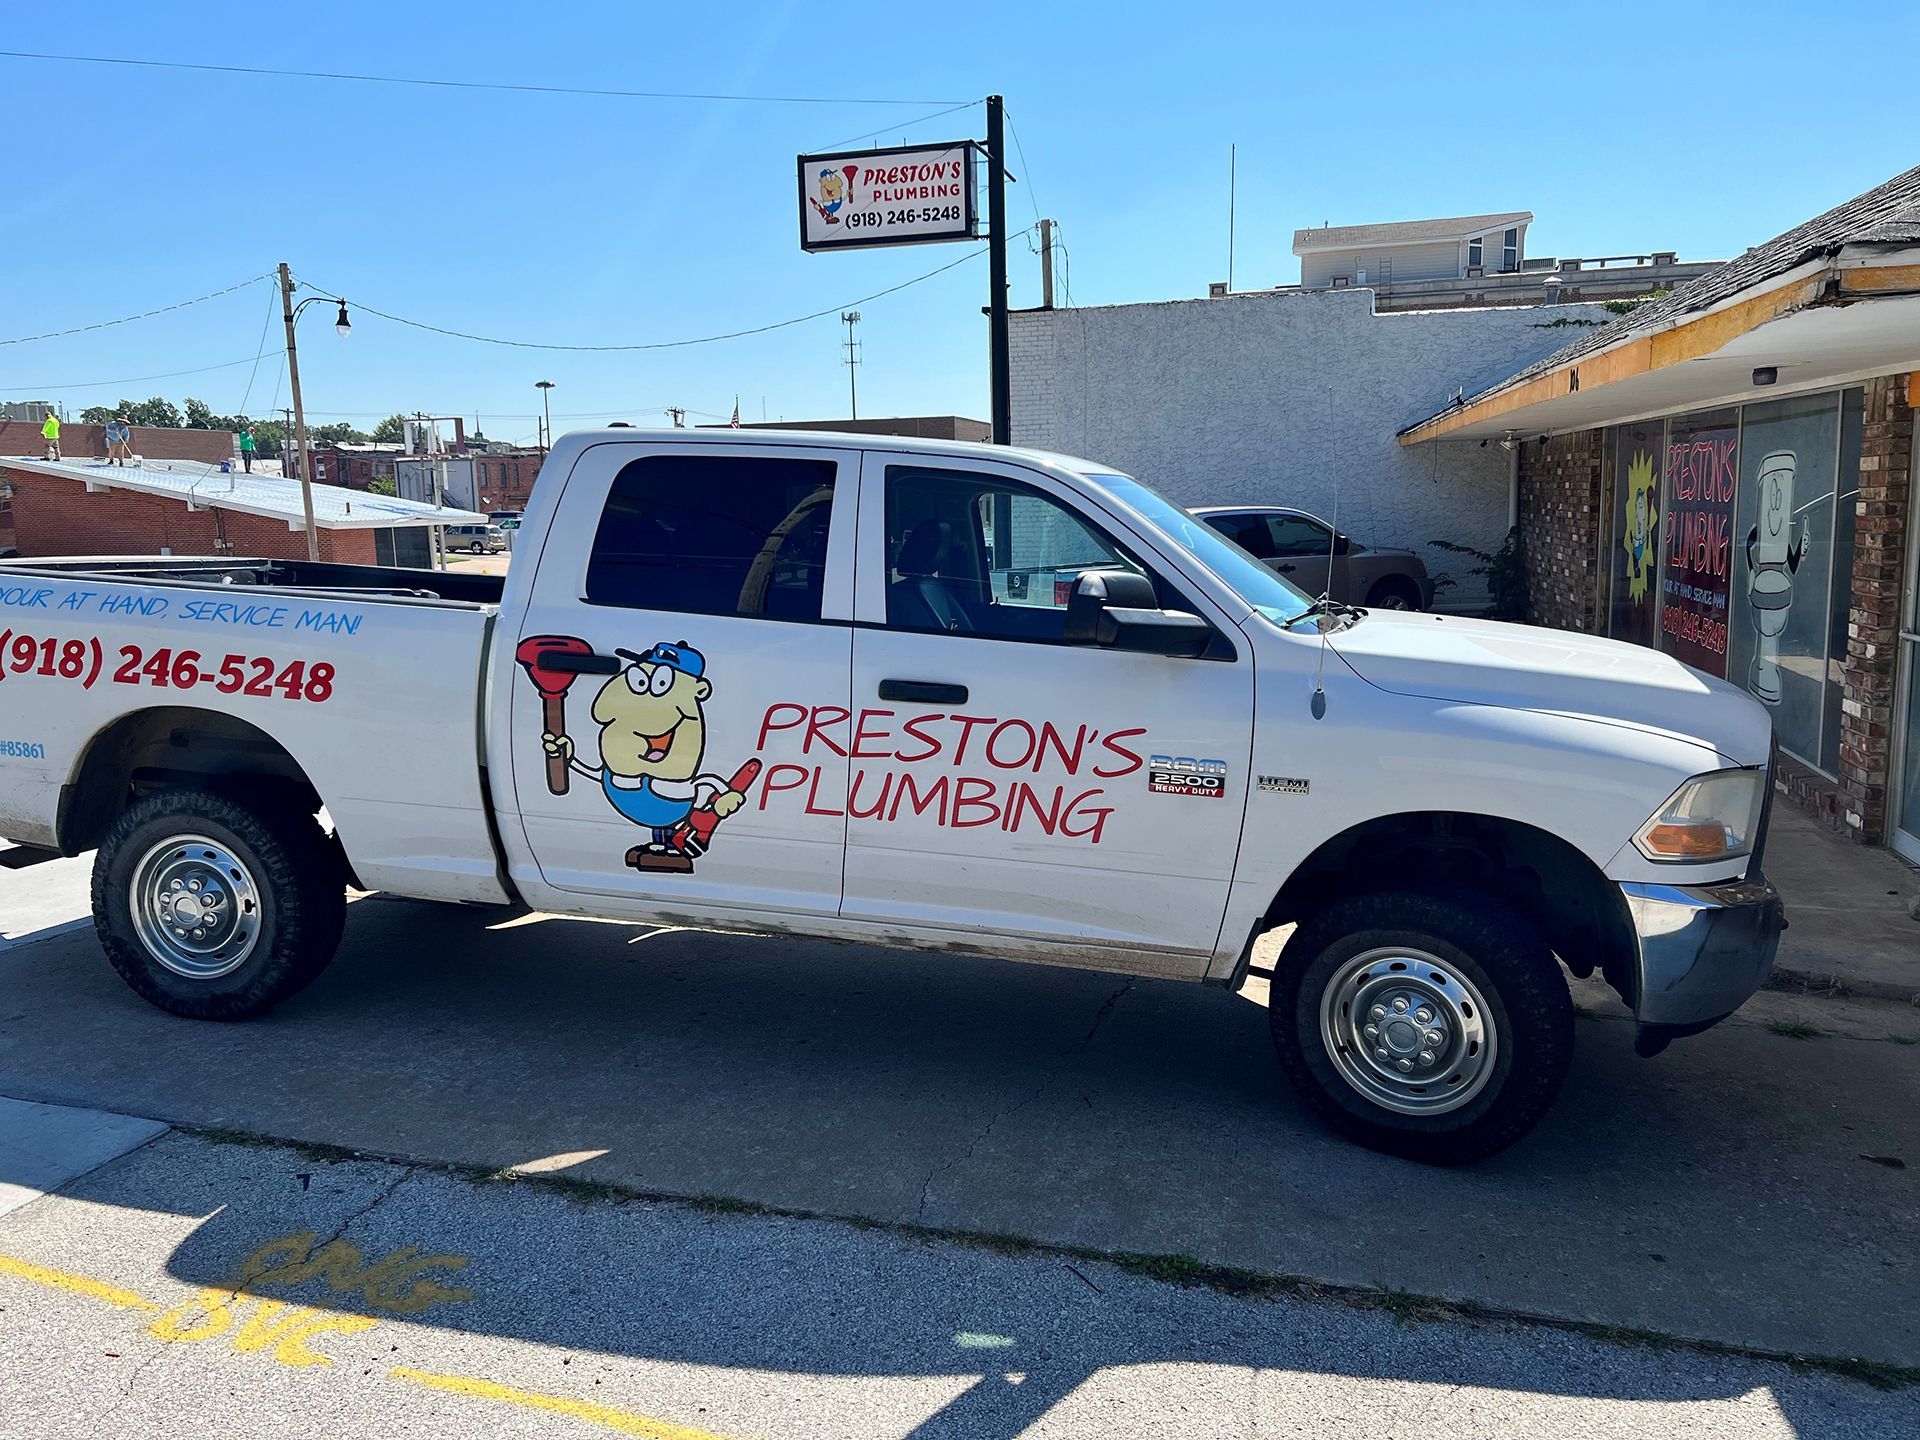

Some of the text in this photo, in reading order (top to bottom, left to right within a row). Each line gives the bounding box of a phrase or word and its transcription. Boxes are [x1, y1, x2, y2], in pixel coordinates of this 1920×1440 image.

[863, 161, 961, 186] PRESTON'S
[873, 183, 961, 203] PLUMBING
[845, 206, 961, 230] (918) 246-5248
[1665, 438, 1736, 503] PRESTON'S
[0, 587, 363, 635] YOUR AT HAND, SERVICE MAN!
[1681, 610, 1727, 655] 246-5248
[0, 628, 336, 703] (918) 246-5248
[0, 740, 45, 760] #85861
[756, 702, 1148, 779] PRESTON'S
[1150, 754, 1227, 774] RAM
[1154, 773, 1219, 788] 2500
[1155, 784, 1218, 797] HEAVY DUTY
[1257, 775, 1309, 788] HEMI
[758, 764, 1115, 845] PLUMBING
